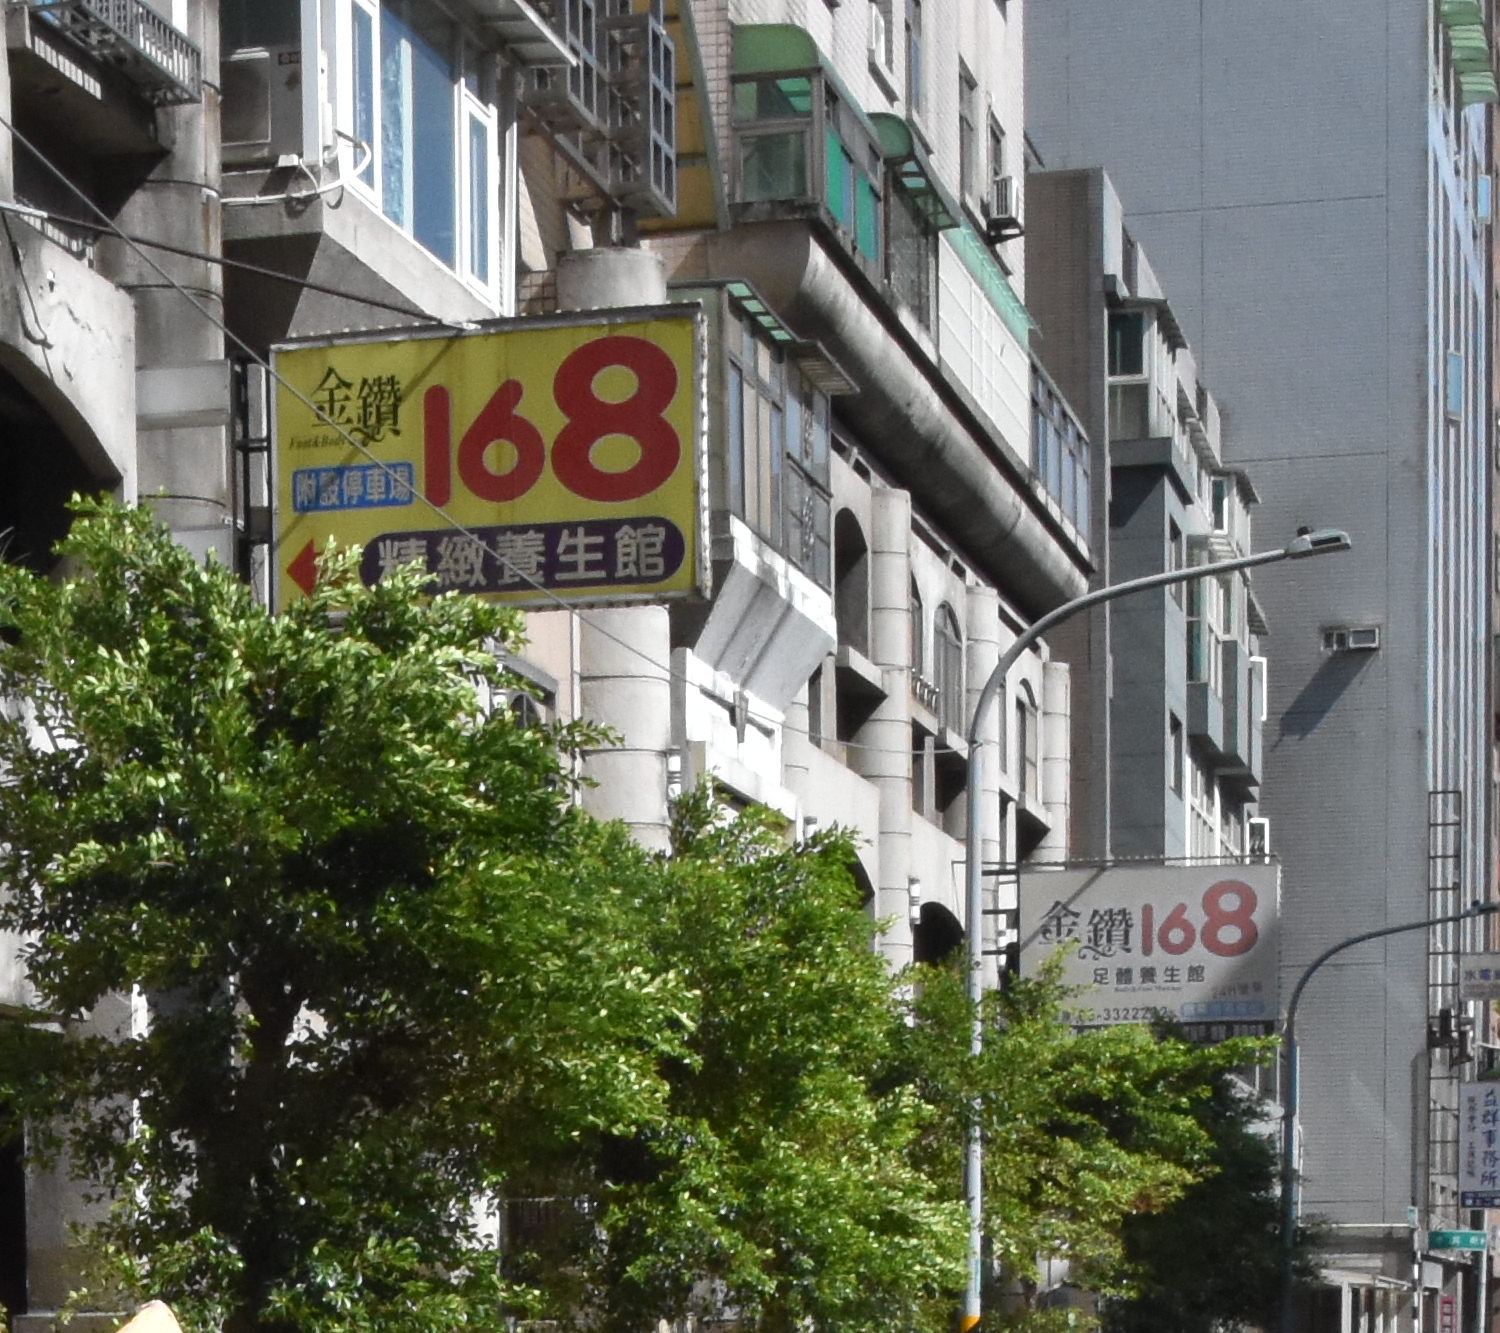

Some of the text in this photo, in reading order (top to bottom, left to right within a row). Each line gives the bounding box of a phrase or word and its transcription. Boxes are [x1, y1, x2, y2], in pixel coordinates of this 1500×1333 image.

[309, 366, 402, 437] 金鑽
[422, 334, 682, 508] 168
[296, 464, 413, 511] 附設停車場
[377, 524, 668, 590] 精緻養生館
[1037, 900, 1135, 957] 金鑽
[1140, 879, 1259, 958] 168
